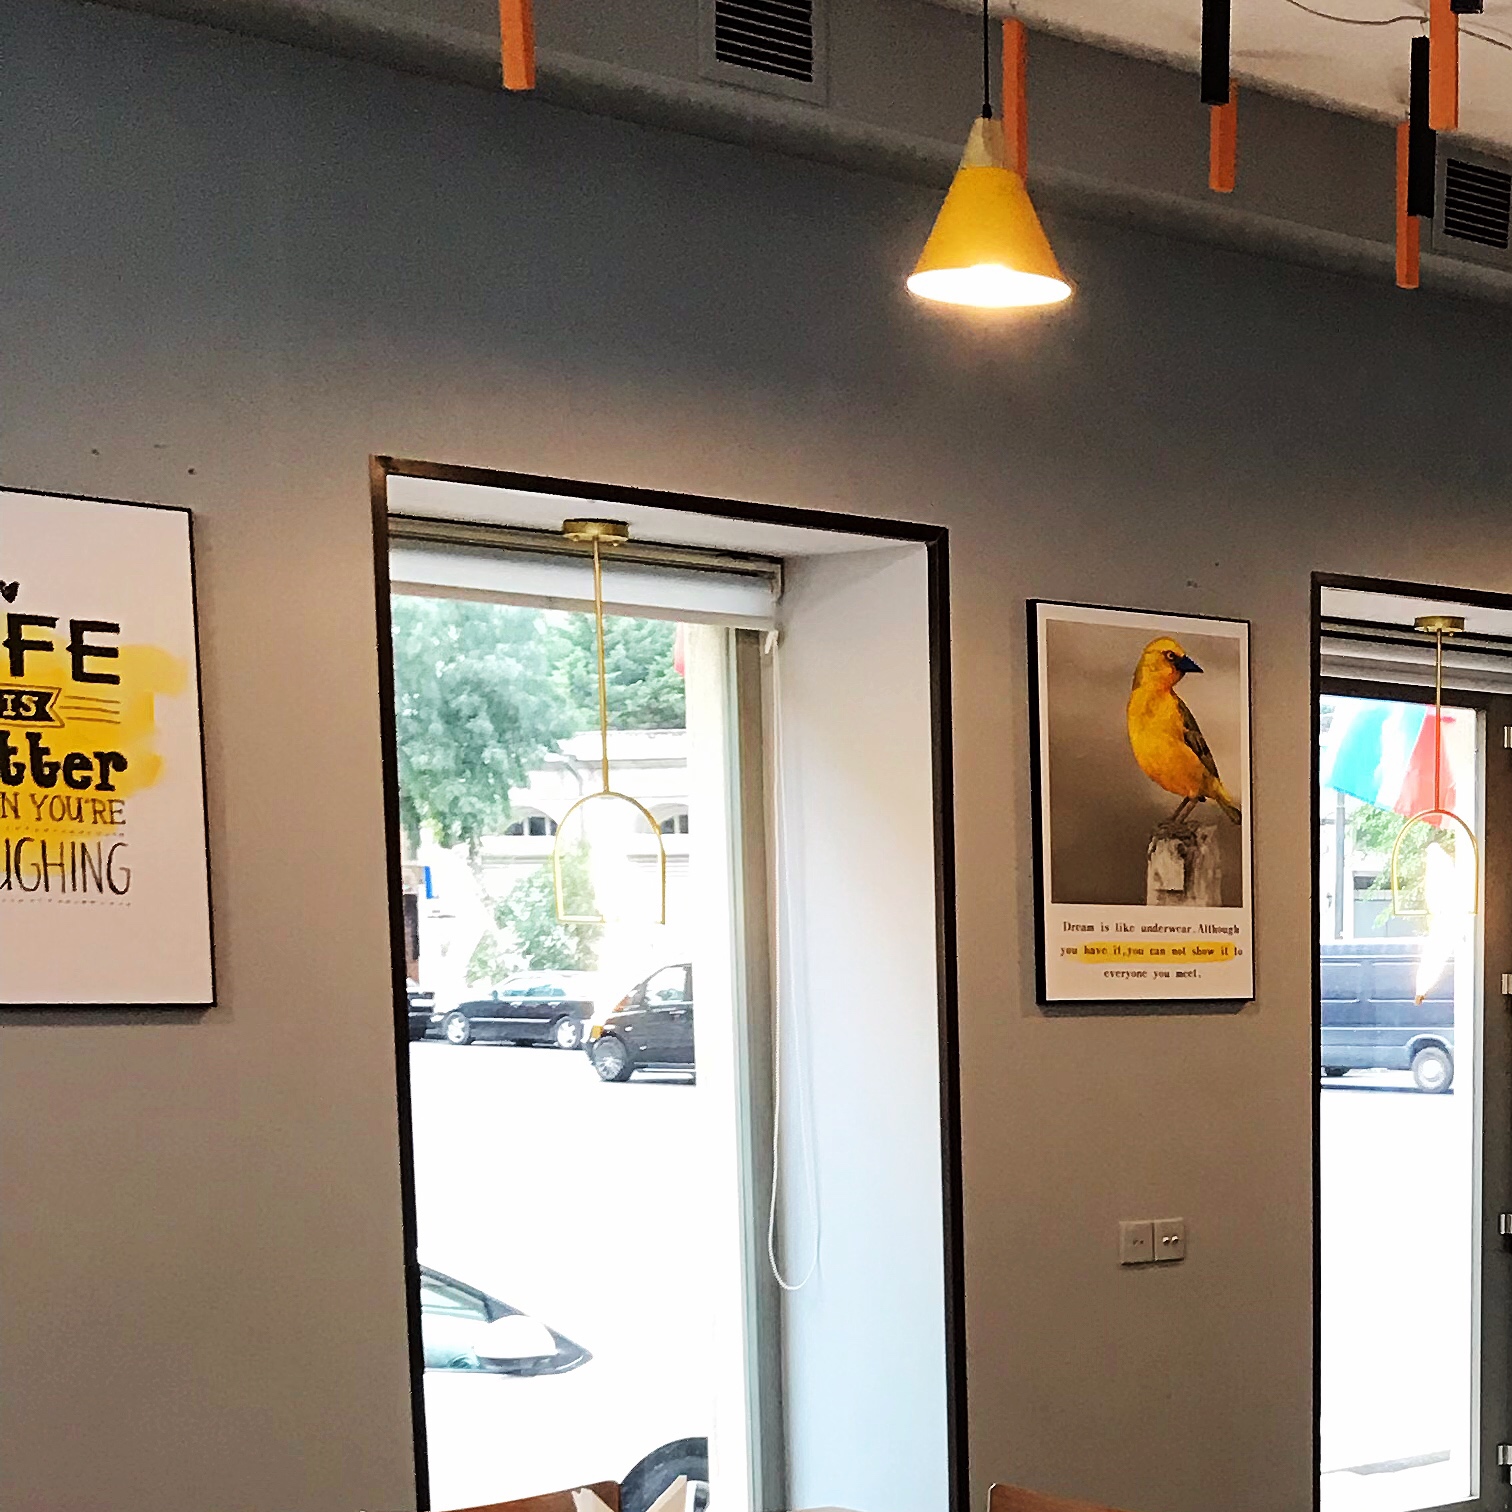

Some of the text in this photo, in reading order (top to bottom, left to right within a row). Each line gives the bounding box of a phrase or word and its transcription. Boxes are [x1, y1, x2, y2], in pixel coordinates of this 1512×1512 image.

[3, 694, 39, 717] IS
[30, 793, 127, 825] YOU'RE
[1063, 921, 1095, 932] Dream
[1100, 922, 1110, 932] is
[1115, 922, 1136, 933] like
[1060, 947, 1078, 957] you
[1083, 945, 1108, 955] have
[1149, 947, 1166, 956] can
[1171, 946, 1186, 956] not
[1191, 945, 1215, 956] show
[1220, 946, 1229, 956] it
[1234, 946, 1243, 956] to
[1103, 968, 1202, 980] everyone you meet.
